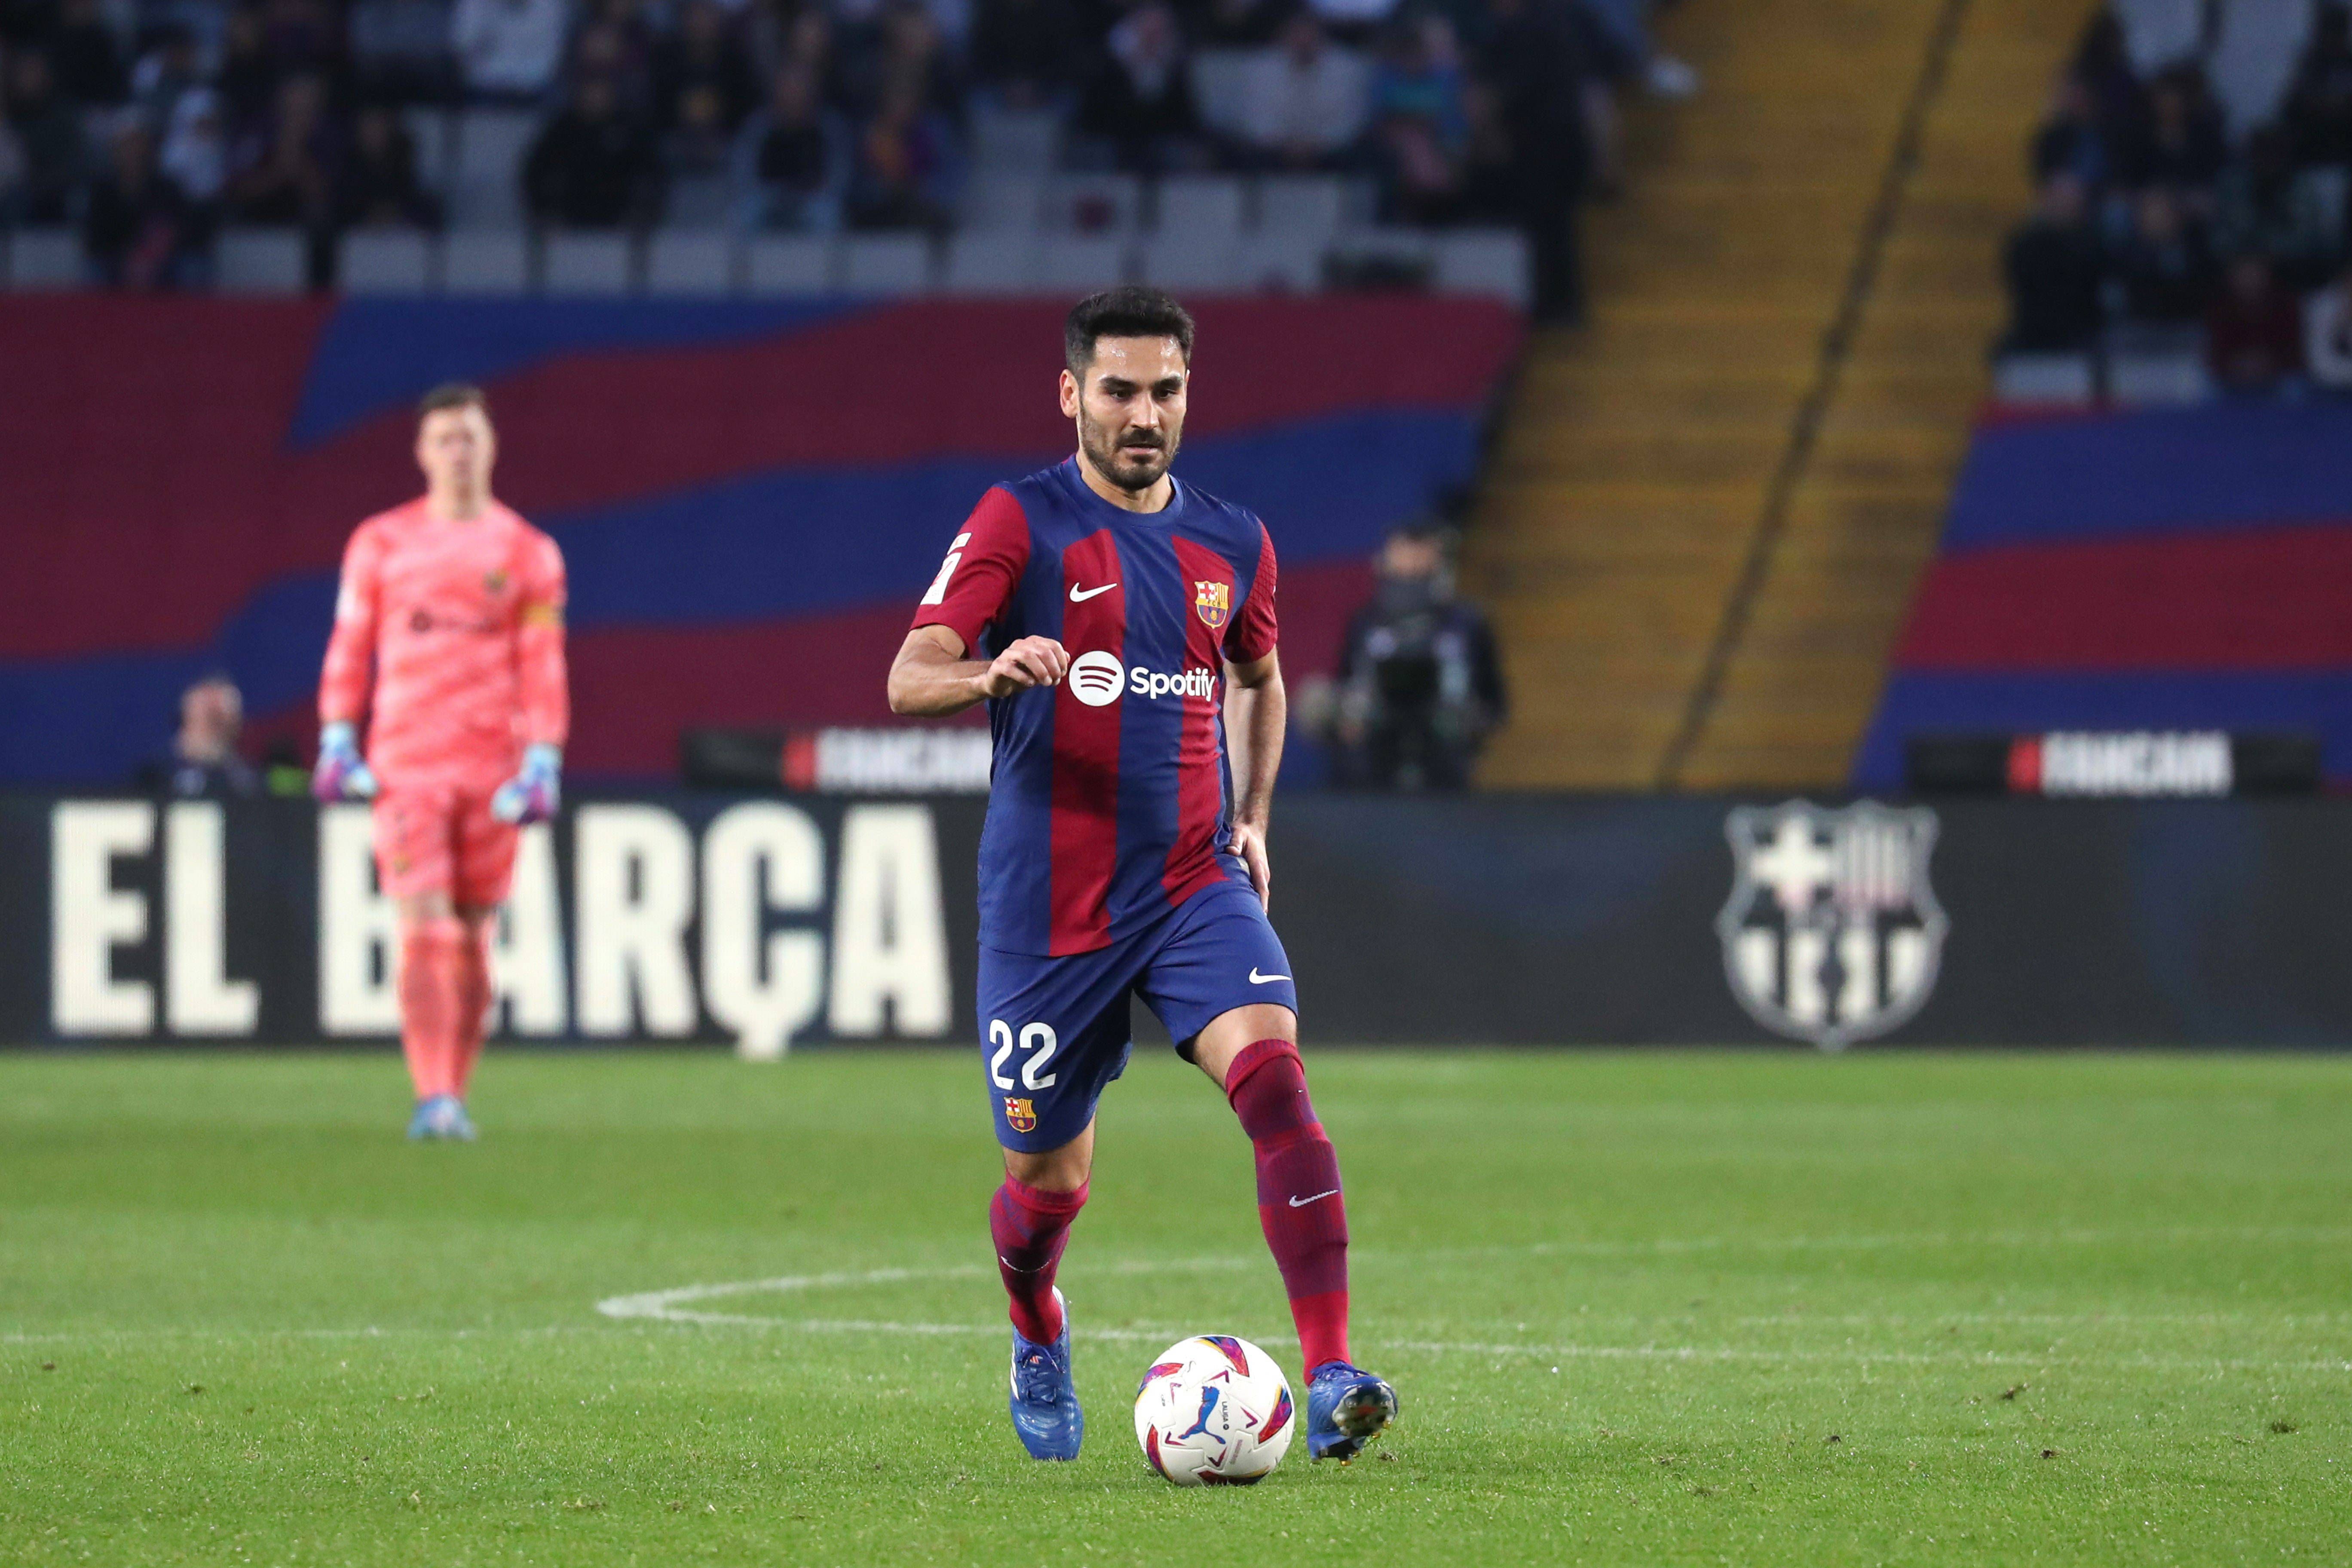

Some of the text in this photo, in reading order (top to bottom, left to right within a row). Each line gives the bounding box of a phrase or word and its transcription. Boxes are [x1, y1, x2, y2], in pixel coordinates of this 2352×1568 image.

[1130, 667, 1216, 701] Spotify
[50, 799, 261, 1037] EL
[989, 1019, 1057, 1090] 22
